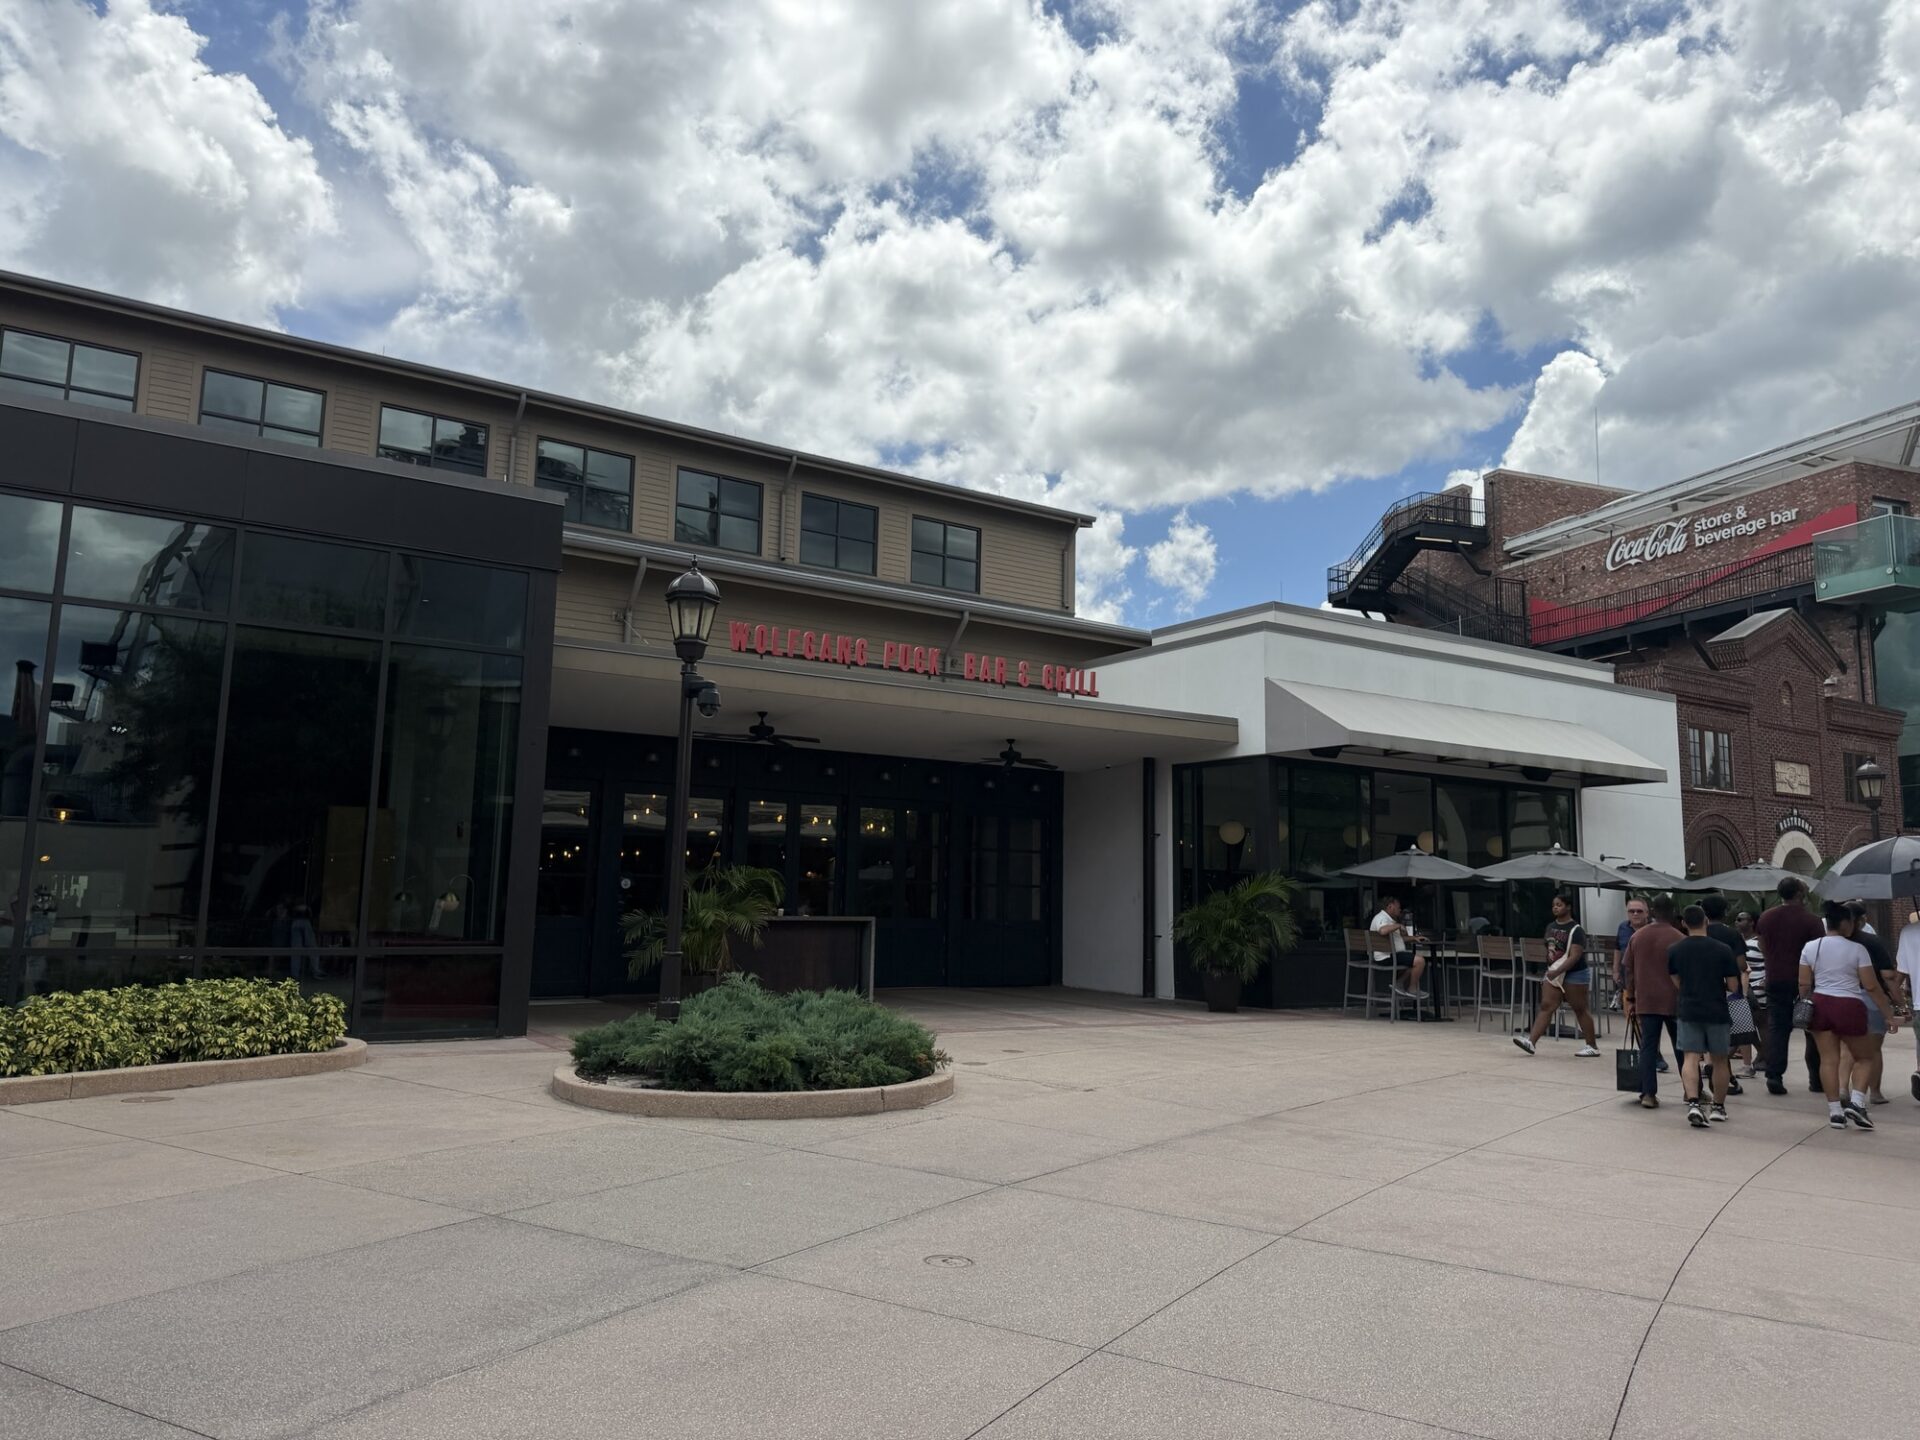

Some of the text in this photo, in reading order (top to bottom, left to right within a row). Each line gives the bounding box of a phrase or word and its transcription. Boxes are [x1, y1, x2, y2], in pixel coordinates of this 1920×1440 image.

[1694, 505, 1748, 533] store &
[1695, 508, 1799, 547] beverage bar
[1606, 516, 1693, 571] Coca-Cola
[729, 620, 1099, 698] WOLFGANG PUCK BAR & GRILL
